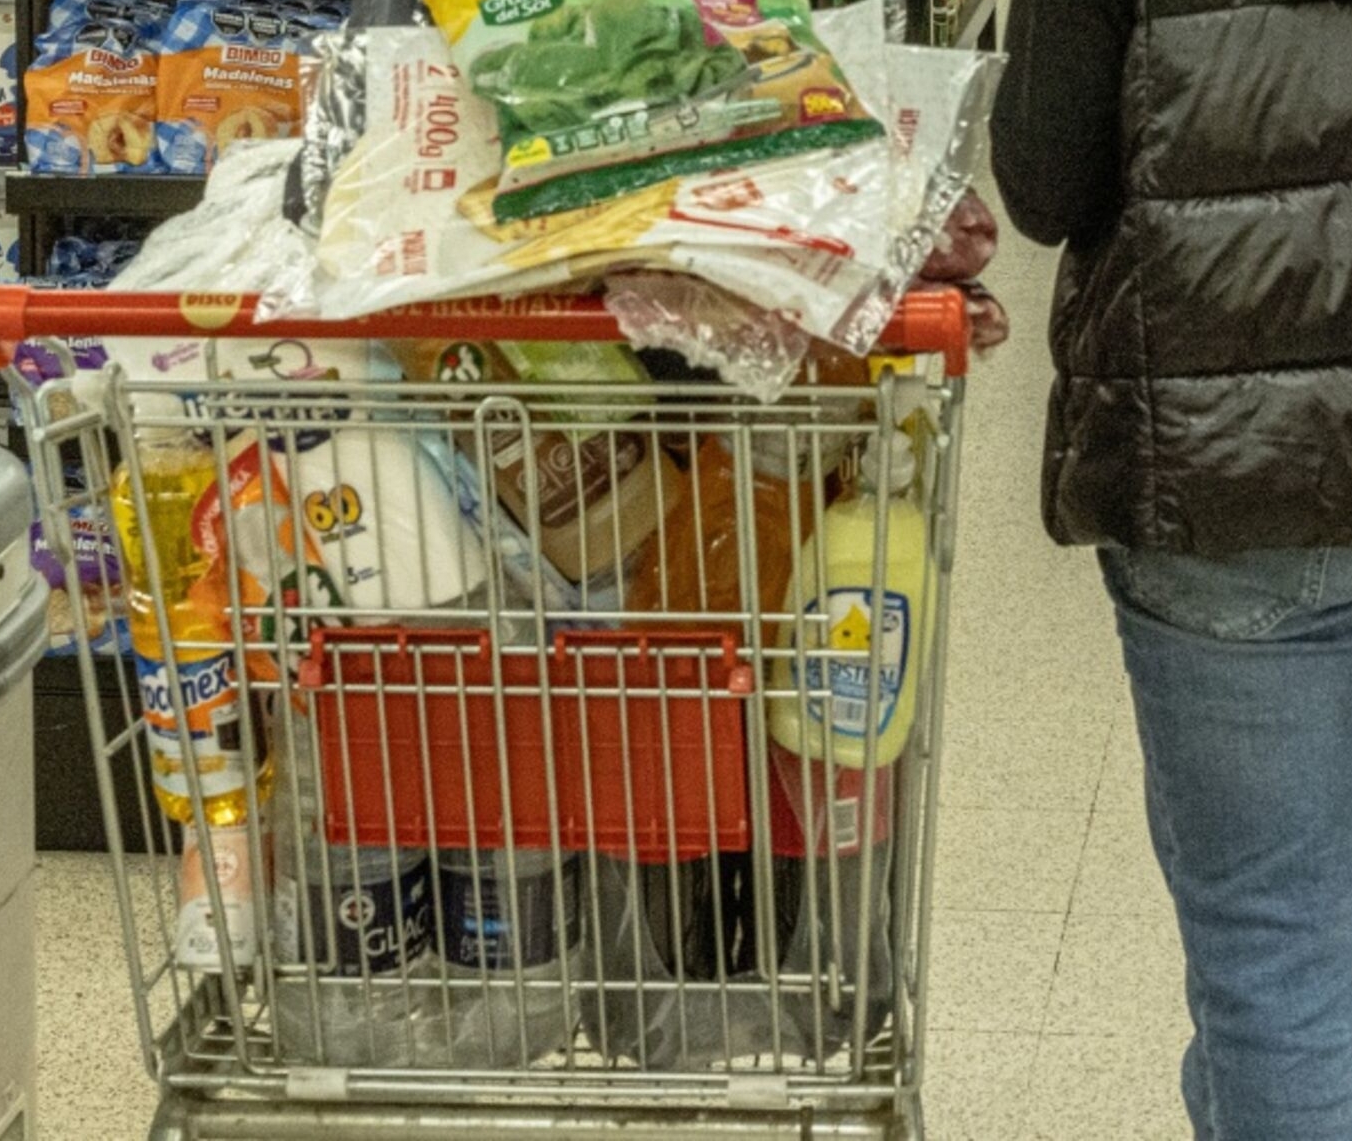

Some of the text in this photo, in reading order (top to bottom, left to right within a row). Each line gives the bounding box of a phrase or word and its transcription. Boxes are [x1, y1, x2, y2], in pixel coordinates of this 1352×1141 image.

[496, 7, 522, 24] del
[226, 46, 283, 65] BIMBO
[203, 66, 295, 90] Madalenas
[418, 93, 460, 160] 400g
[303, 482, 363, 533] 60
